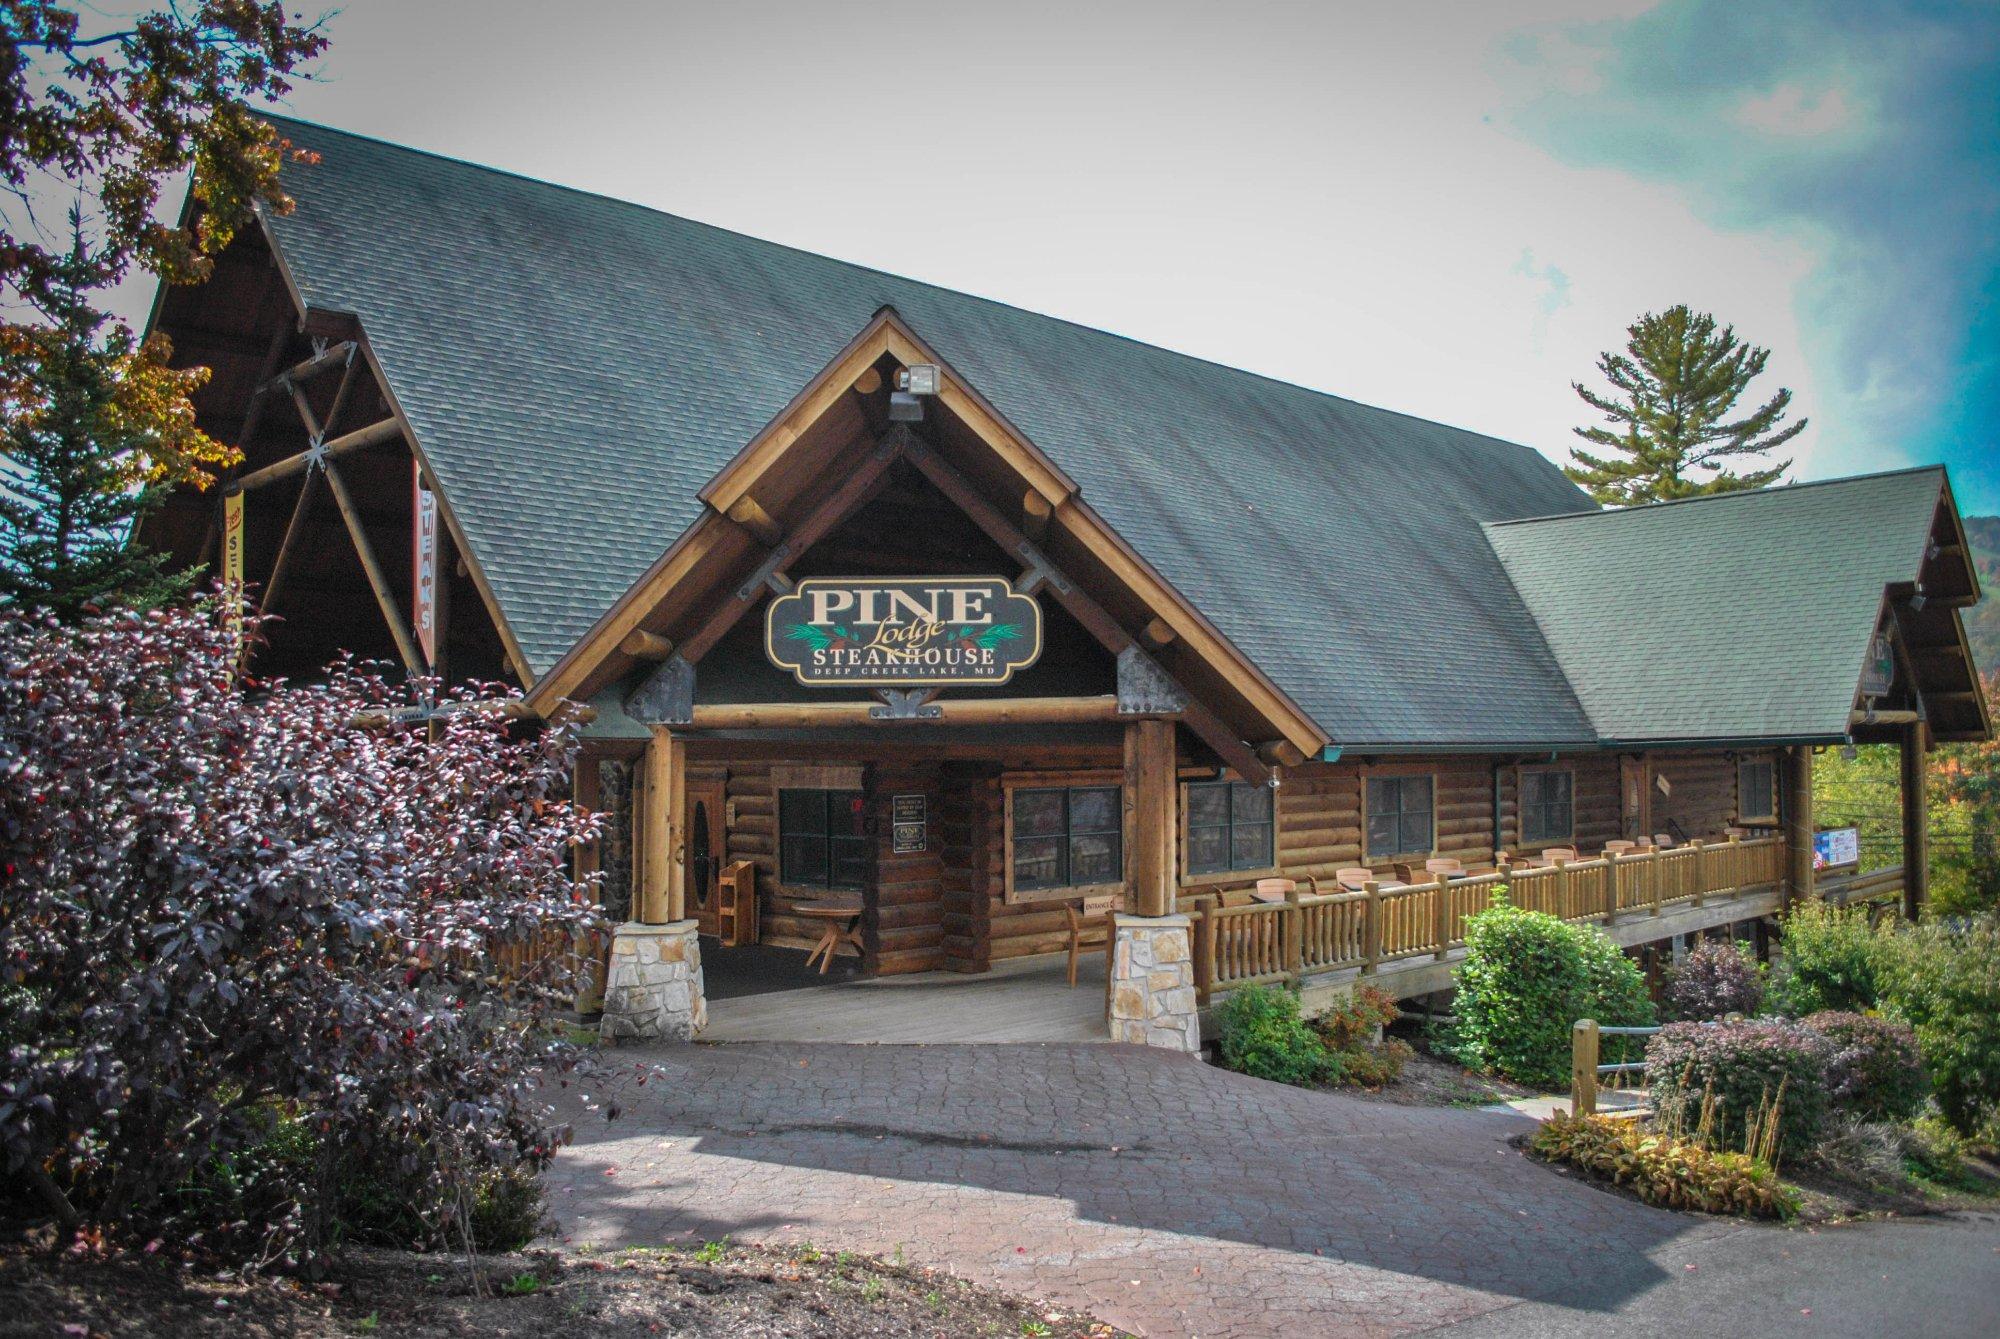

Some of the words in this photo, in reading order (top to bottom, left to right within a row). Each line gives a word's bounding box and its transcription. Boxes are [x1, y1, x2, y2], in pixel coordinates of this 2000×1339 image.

[420, 490, 432, 630] STEAKS
[806, 588, 993, 625] PINE
[863, 612, 946, 658] Lodge
[813, 648, 994, 665] STEAKHOUSE
[814, 667, 851, 675] DEEP
[861, 667, 909, 675] CREEK
[919, 667, 964, 676] LAKE,
[975, 667, 995, 675] MD
[1085, 901, 1110, 911] ENTRANCE
